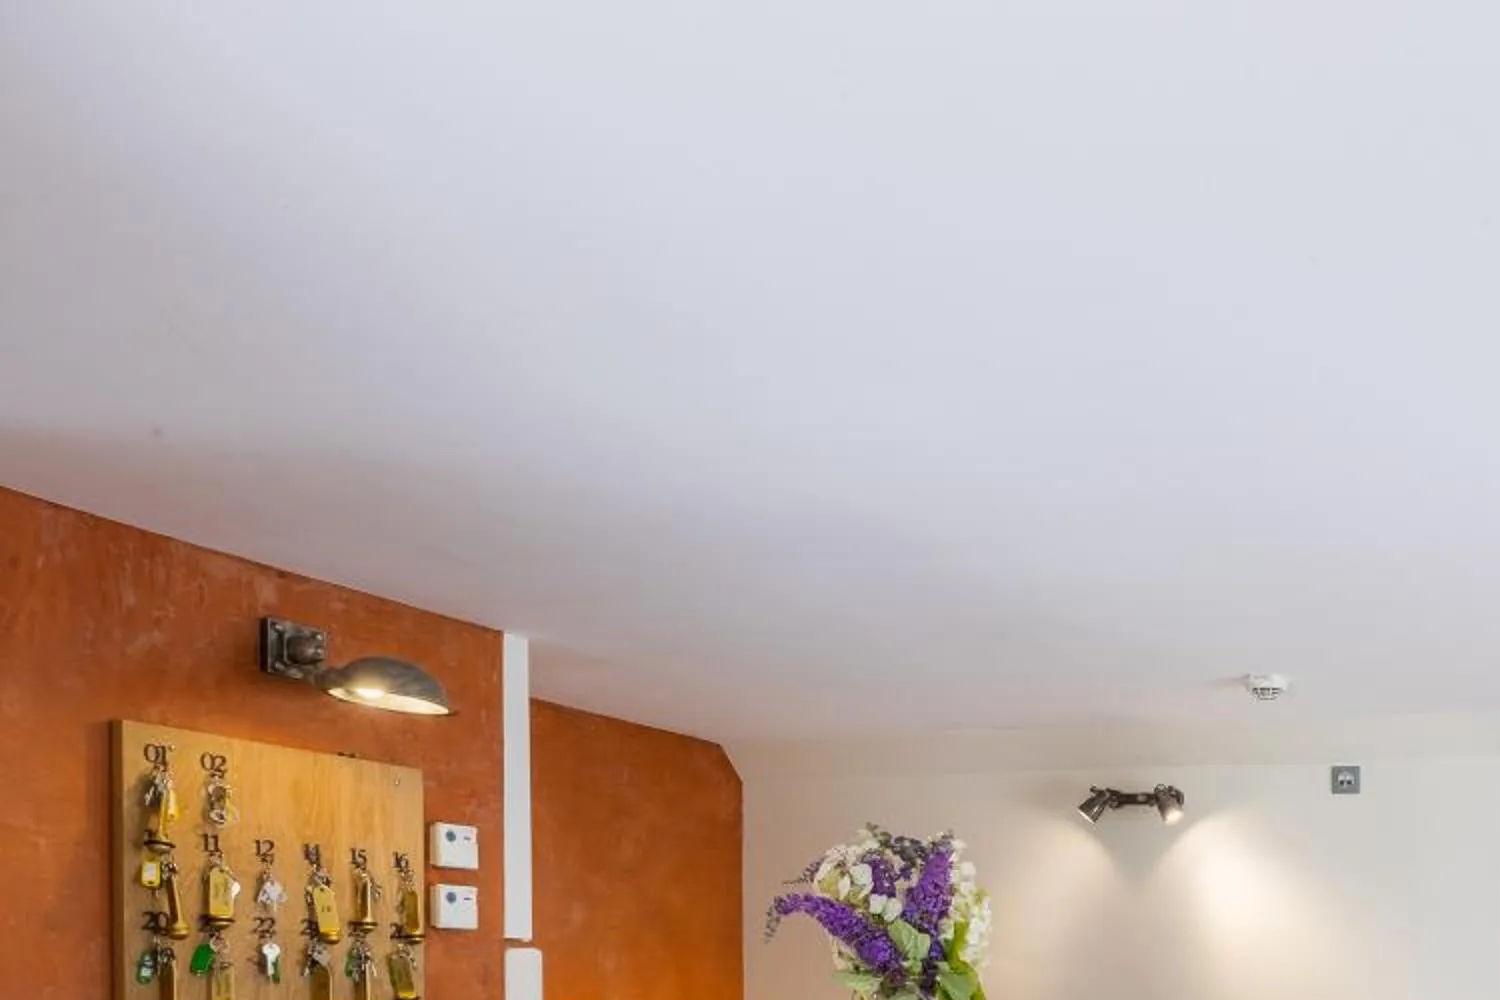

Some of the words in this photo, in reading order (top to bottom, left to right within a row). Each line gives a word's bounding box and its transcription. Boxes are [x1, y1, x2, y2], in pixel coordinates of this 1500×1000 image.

[143, 744, 167, 768] 01
[200, 752, 227, 773] 02
[203, 834, 219, 852] 11
[256, 839, 276, 857] 12
[252, 917, 276, 934] 22
